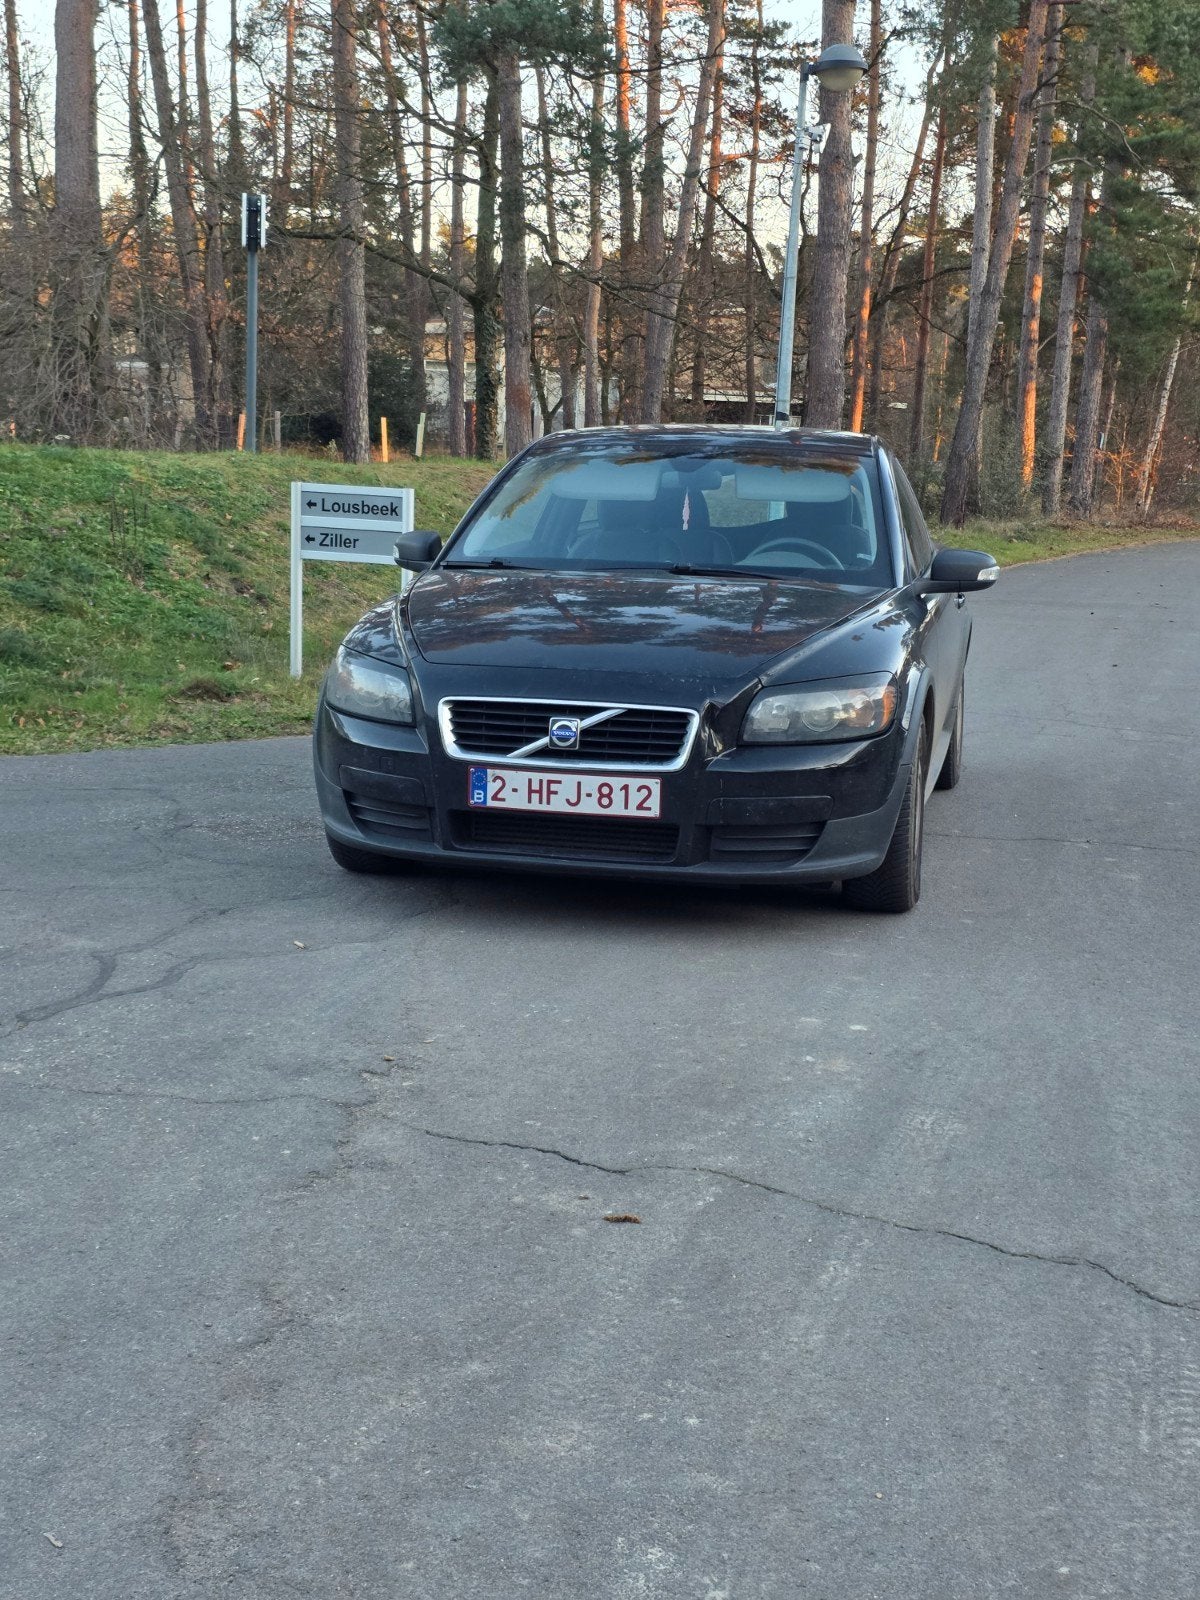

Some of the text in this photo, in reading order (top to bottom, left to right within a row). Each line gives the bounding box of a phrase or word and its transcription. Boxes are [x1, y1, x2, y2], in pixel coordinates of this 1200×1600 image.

[321, 498, 399, 516] Lousbeek
[319, 533, 360, 549] Ziller
[474, 775, 653, 811] B 2-HFJ-812
